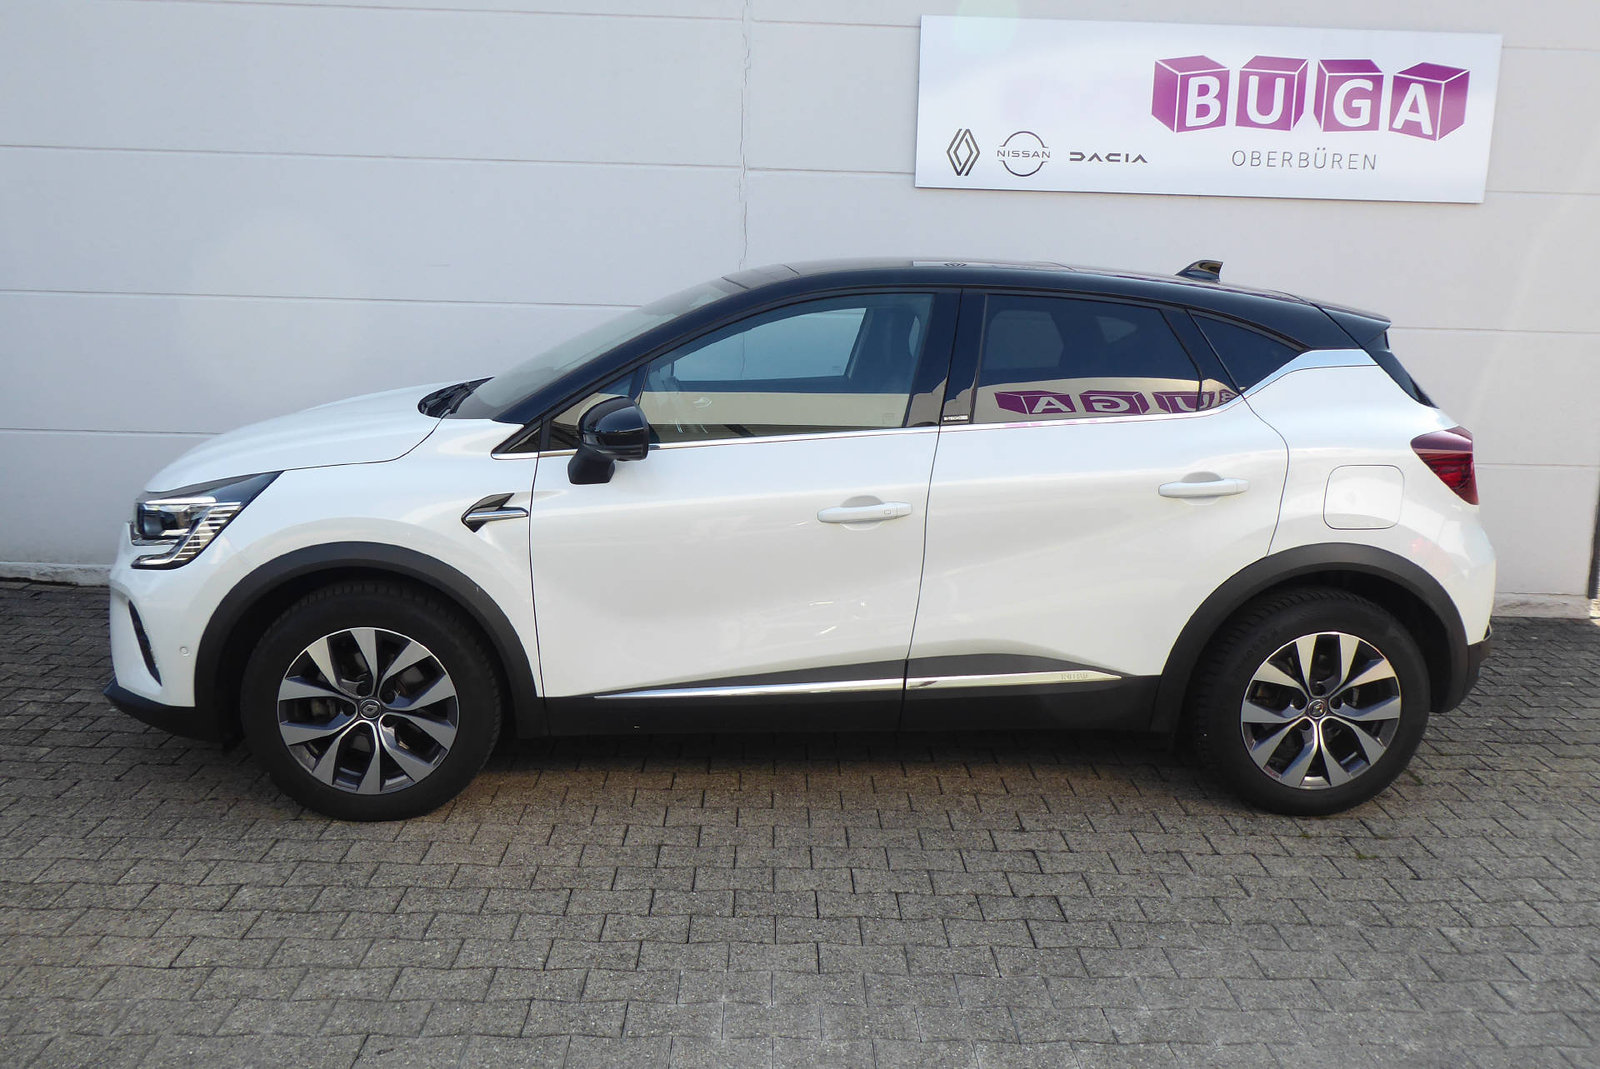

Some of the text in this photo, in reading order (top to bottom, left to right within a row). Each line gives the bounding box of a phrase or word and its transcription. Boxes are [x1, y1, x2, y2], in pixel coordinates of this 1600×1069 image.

[1185, 75, 1434, 136] BUGA
[996, 149, 1051, 159] NISSAN
[1069, 151, 1149, 164] DACIA
[1231, 147, 1377, 170] OBERBÜREN
